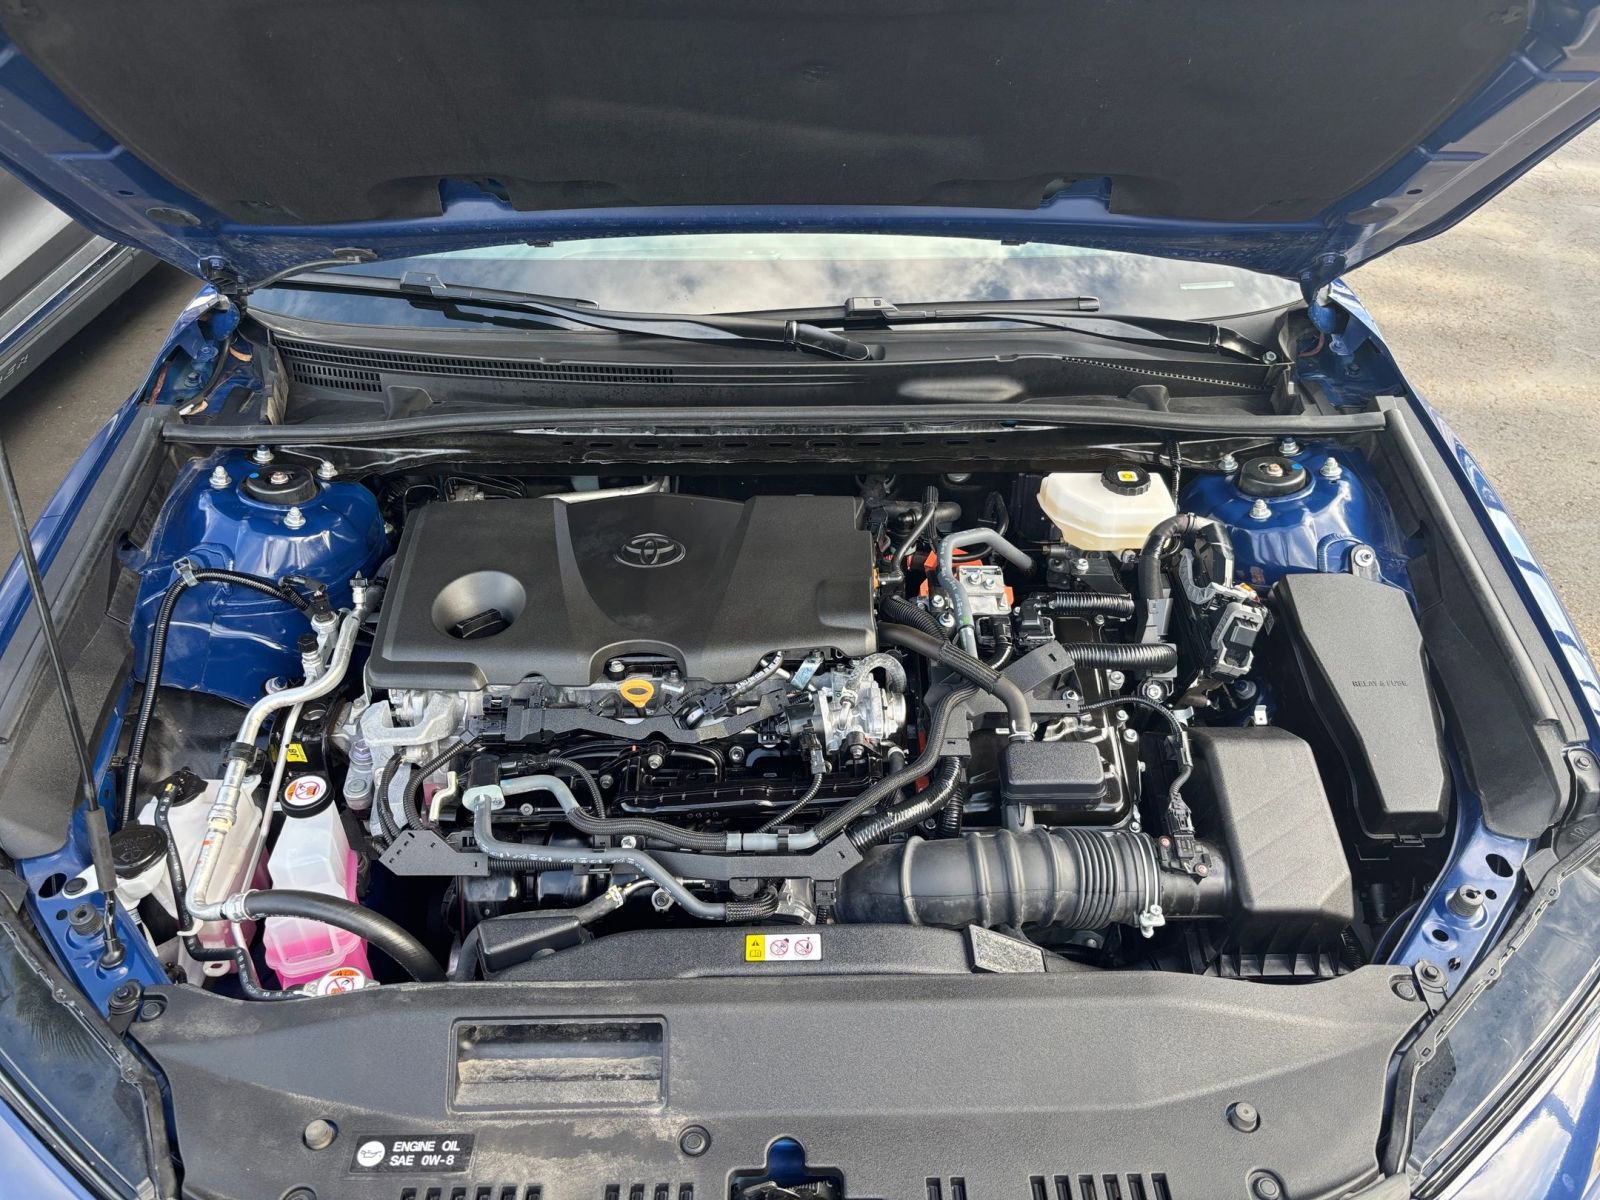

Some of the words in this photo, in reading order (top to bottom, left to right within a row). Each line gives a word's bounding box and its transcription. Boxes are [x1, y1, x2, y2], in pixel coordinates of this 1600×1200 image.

[392, 1141, 436, 1152] ENGINE
[441, 1140, 461, 1152] OIL
[389, 1155, 415, 1167] SAE
[421, 1154, 455, 1166] 0W-8
